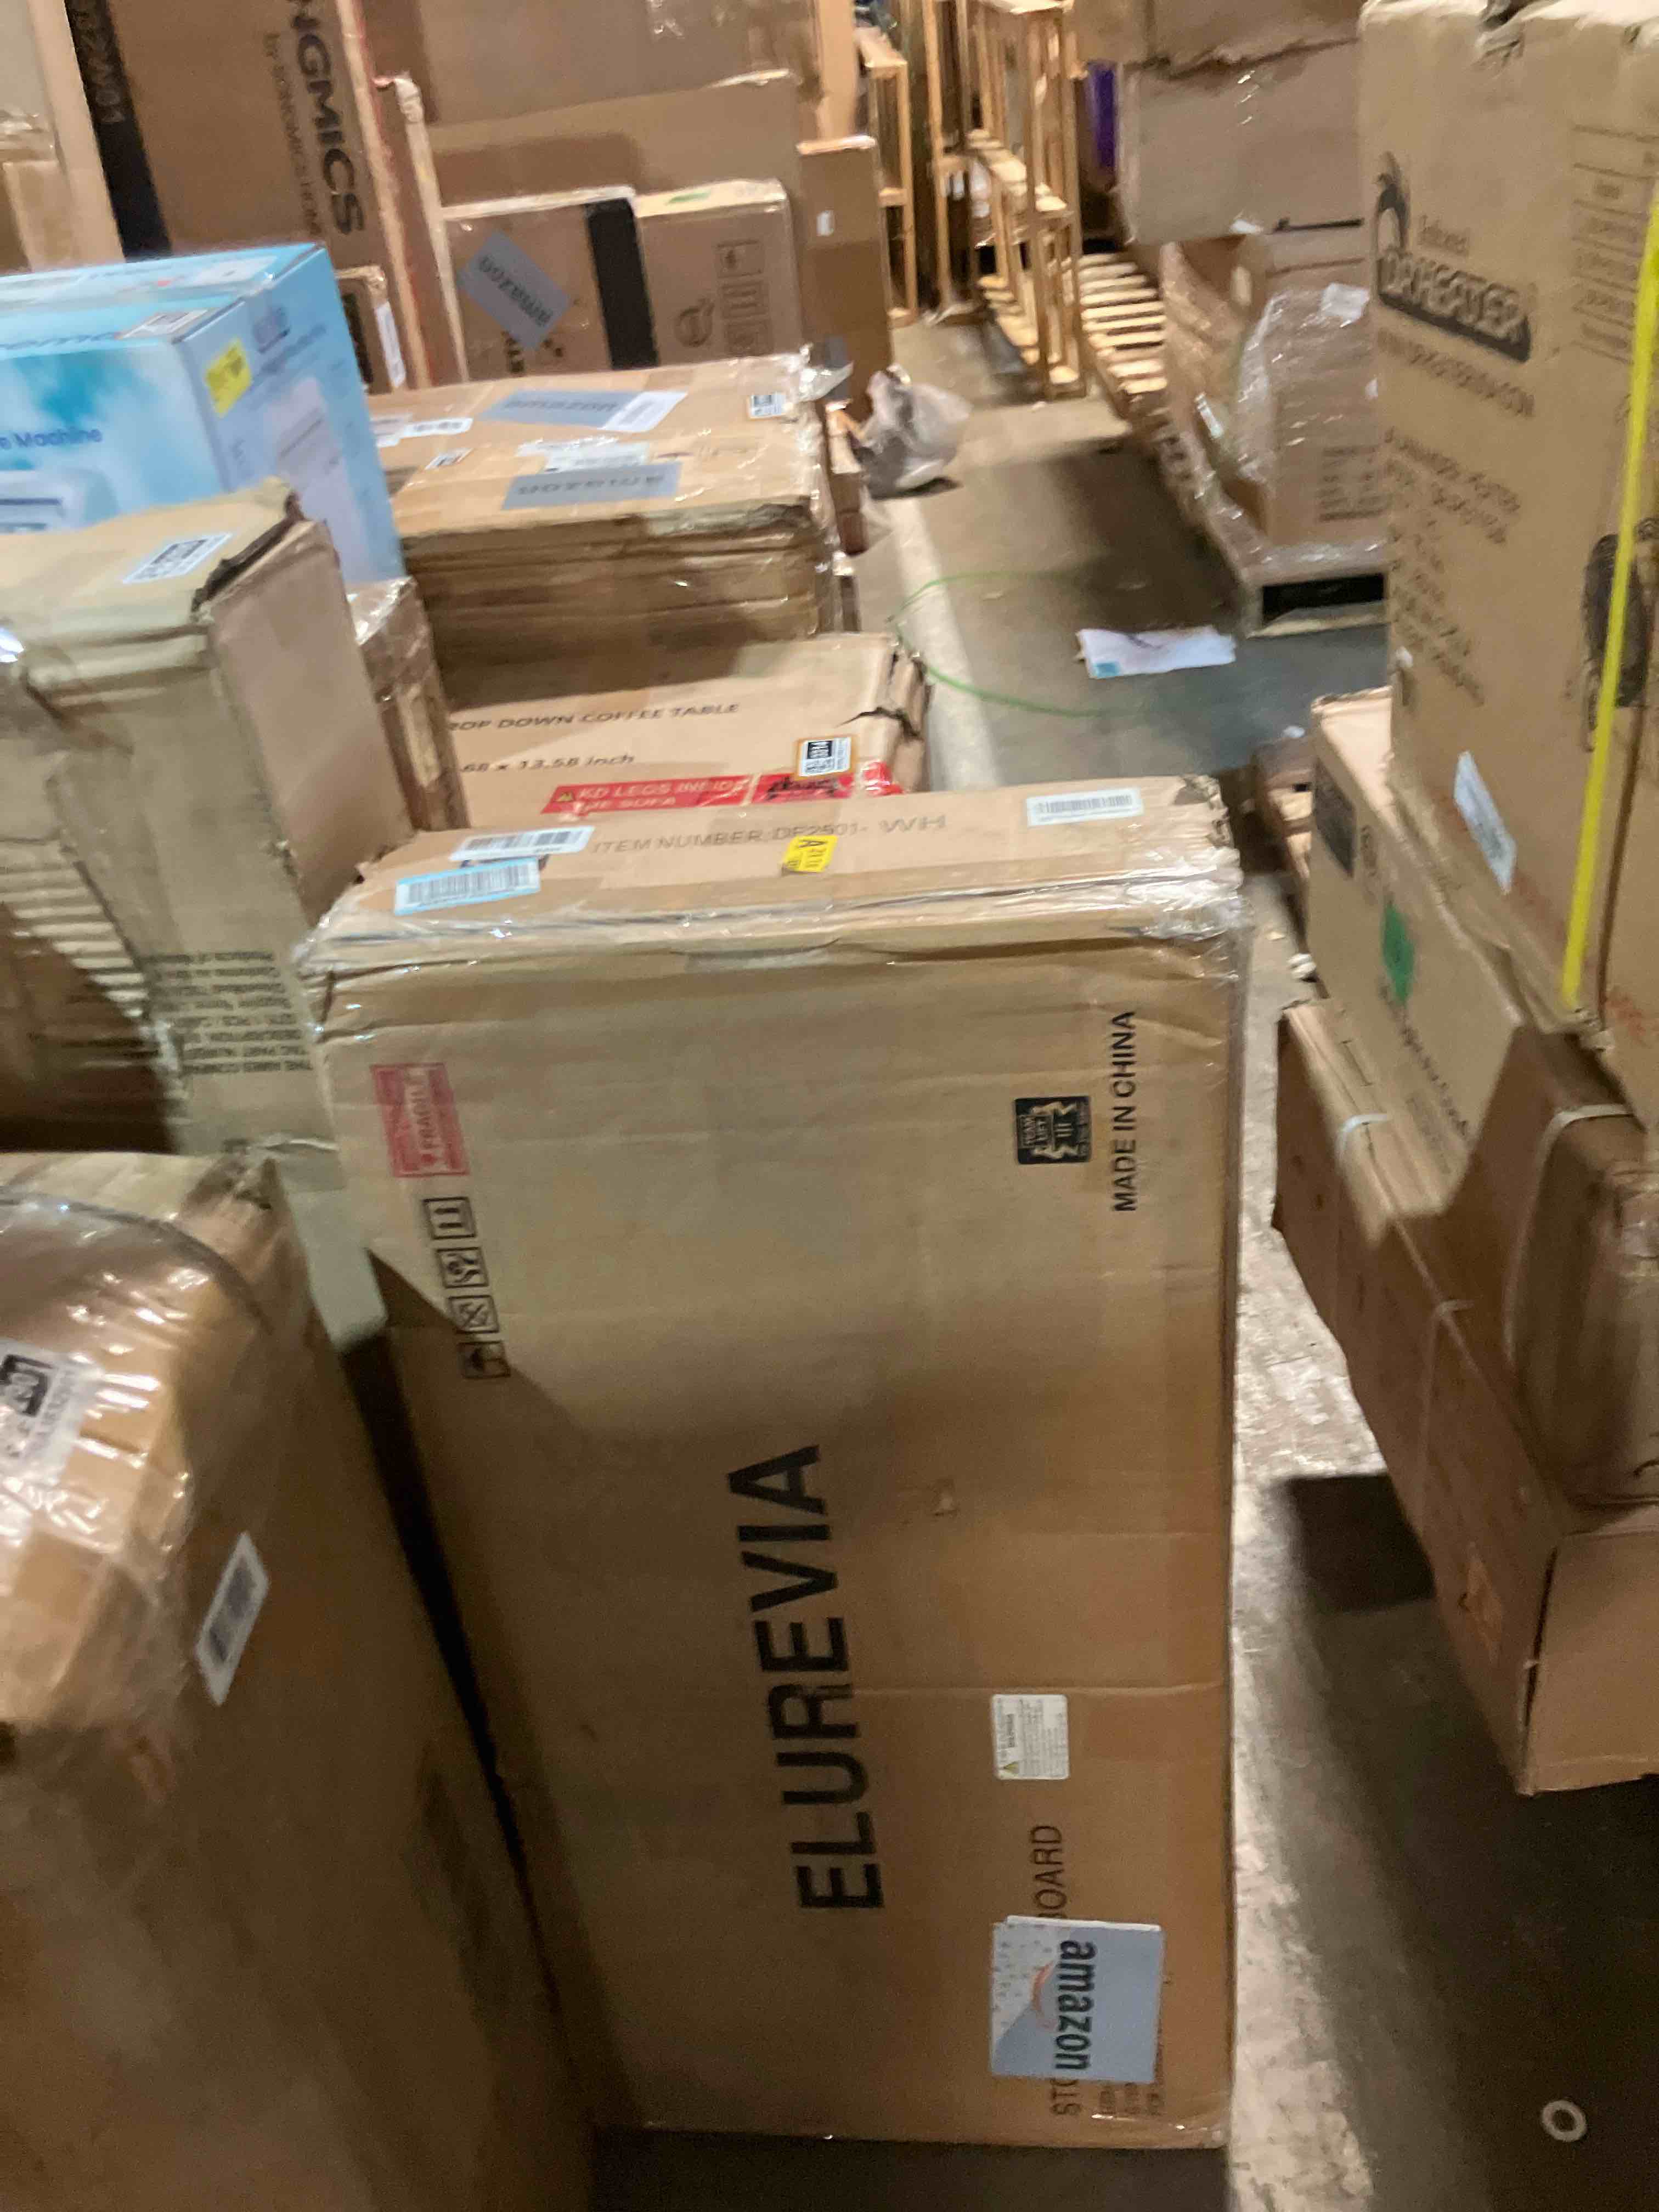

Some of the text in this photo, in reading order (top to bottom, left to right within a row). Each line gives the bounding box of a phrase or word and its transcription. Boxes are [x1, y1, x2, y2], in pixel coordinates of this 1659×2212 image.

[498, 715, 575, 729] DOWN
[579, 709, 663, 722] COFFEE
[670, 704, 740, 716] TABLE
[587, 753, 635, 765] inch
[614, 782, 672, 797] LEGS
[592, 838, 651, 853] ITEM
[878, 815, 946, 833] WH
[1111, 1011, 1137, 1211] MADE IN CHINA
[727, 1444, 884, 1909] ELUREVIA
[1030, 1824, 1068, 1919] OARD
[1054, 1938, 1097, 2072] amazon
